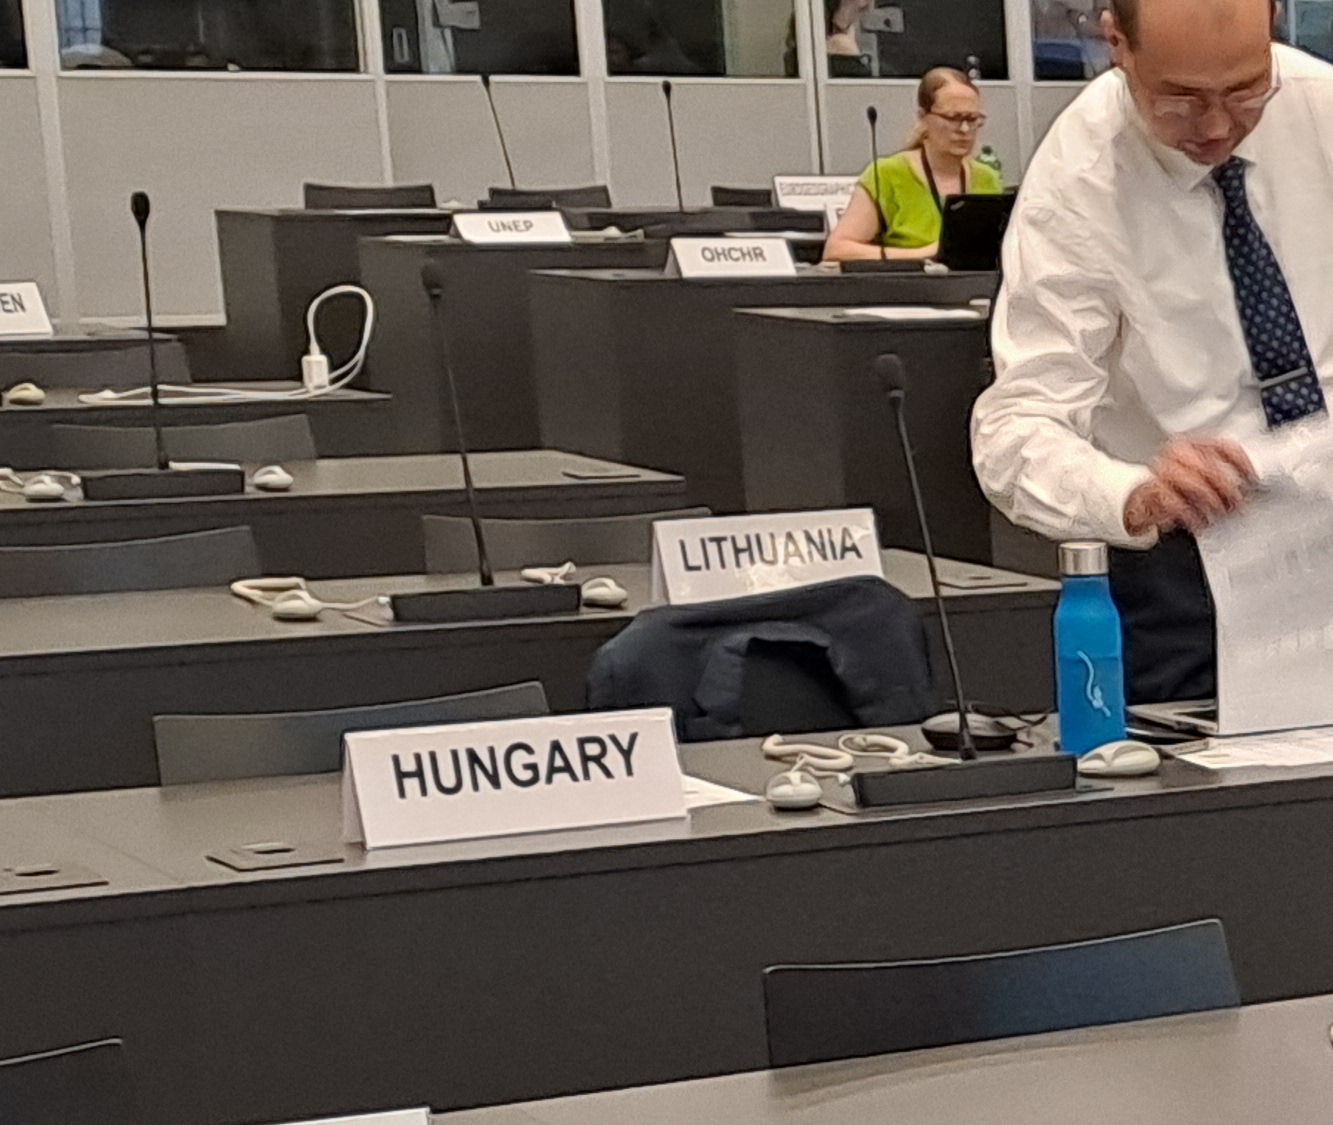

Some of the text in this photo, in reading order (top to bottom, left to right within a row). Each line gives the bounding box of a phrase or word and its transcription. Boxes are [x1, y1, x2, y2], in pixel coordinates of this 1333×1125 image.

[488, 219, 534, 233] UNEP
[701, 246, 768, 263] OHCHR
[678, 526, 864, 572] LITHUANIA
[391, 731, 639, 800] HUNGARY
